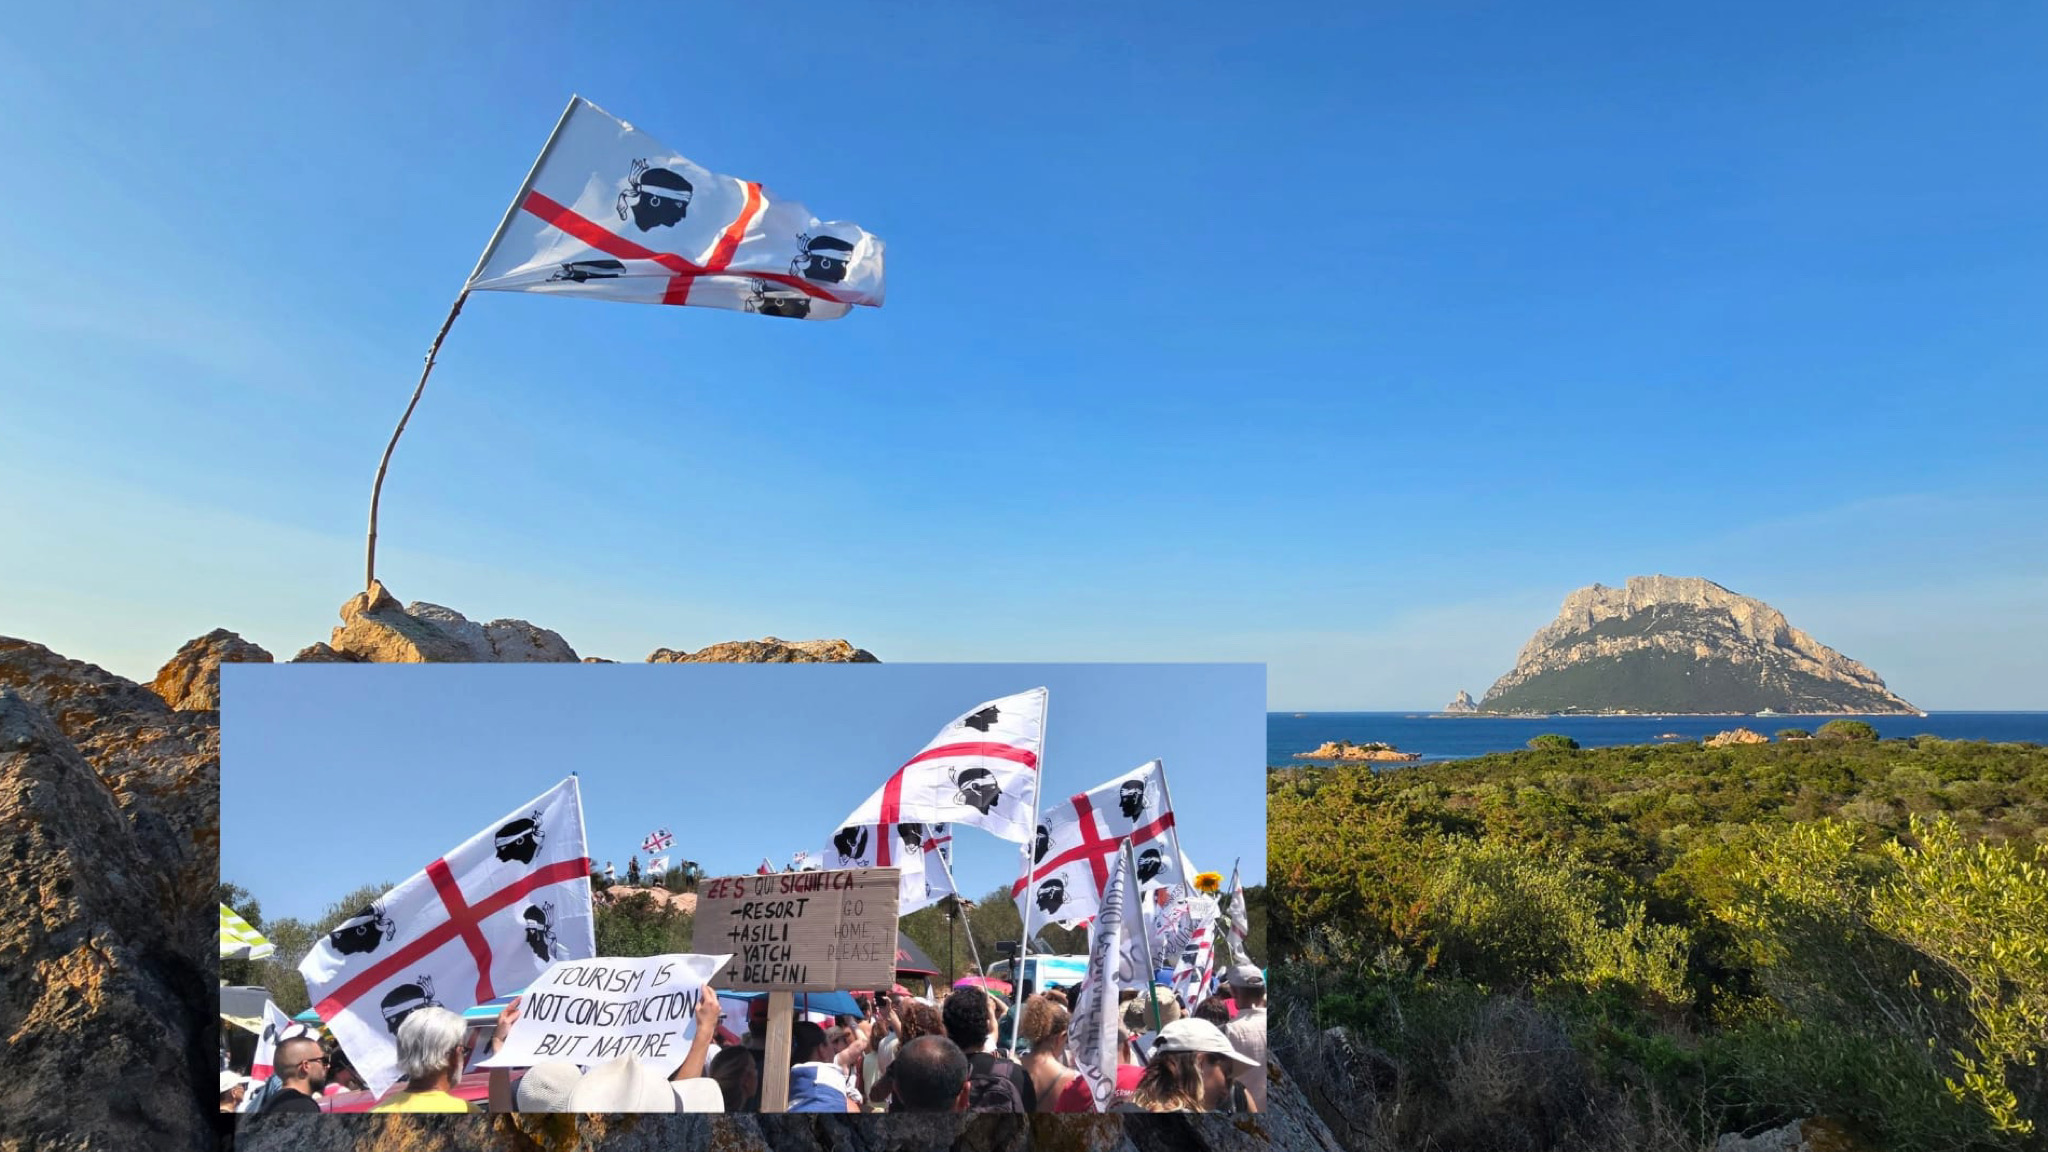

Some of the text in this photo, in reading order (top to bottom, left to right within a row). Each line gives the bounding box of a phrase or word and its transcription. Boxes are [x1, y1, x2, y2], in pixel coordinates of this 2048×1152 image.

[707, 877, 745, 899] ZES
[754, 877, 774, 895] QUI
[843, 899, 863, 917] GO
[553, 963, 675, 991] TOURISM IS
[524, 989, 698, 1026] NOT CONSTRUCTION
[534, 1031, 676, 1058] BUT NATURE
